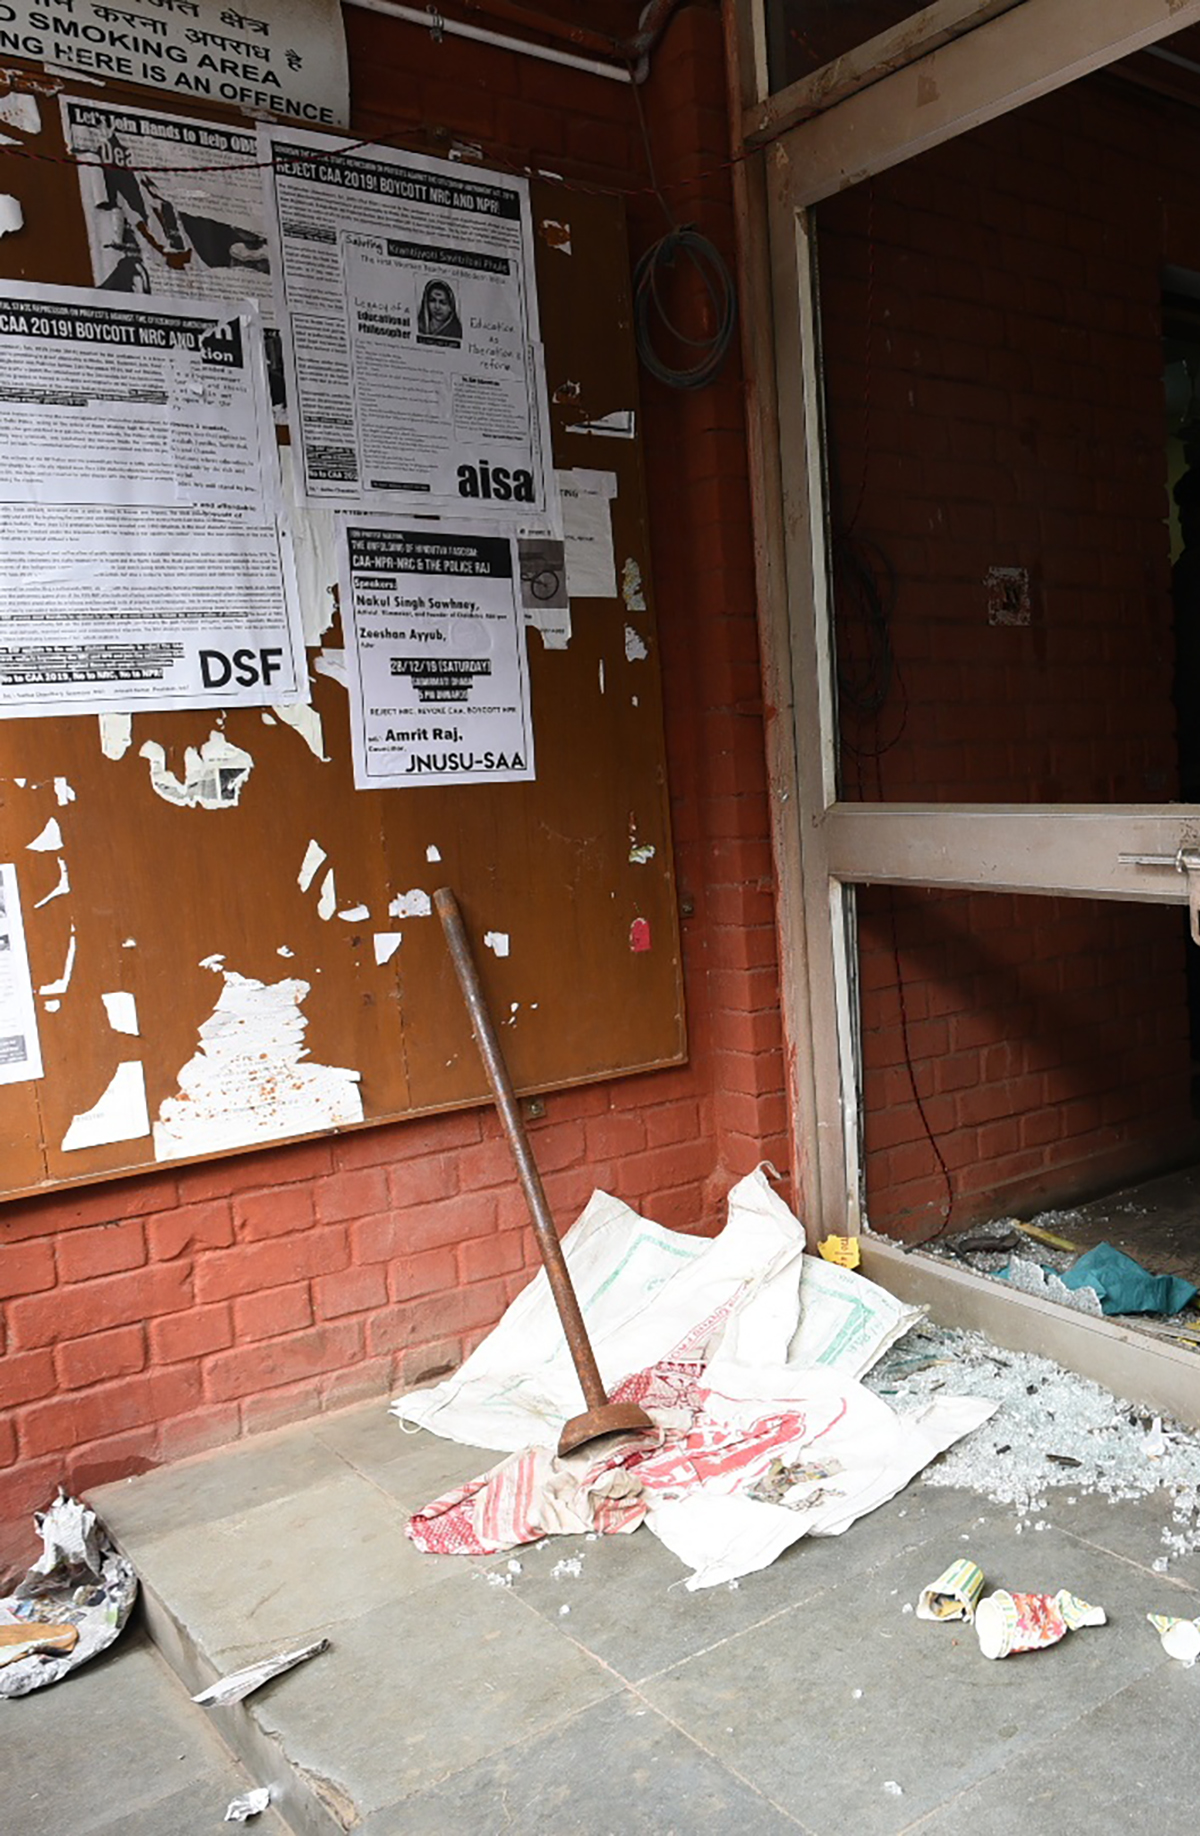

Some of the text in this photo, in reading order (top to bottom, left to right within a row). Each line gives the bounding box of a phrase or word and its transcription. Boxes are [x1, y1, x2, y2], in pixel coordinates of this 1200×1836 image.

[90, 3, 303, 72] करना अपराध है
[220, 7, 270, 36] क्षेत्र
[29, 12, 187, 63] SMOKING
[197, 54, 281, 88] AREA
[54, 42, 133, 76] HERE
[142, 62, 167, 82] IS
[174, 71, 210, 94] AN
[219, 82, 343, 126] OFFENCE.
[75, 108, 106, 127] Let's
[109, 114, 138, 137] Join
[140, 120, 181, 141] Hands
[183, 128, 197, 143] to
[199, 130, 228, 151] Help
[276, 157, 316, 179] REJECT
[319, 165, 342, 184] CAA
[344, 170, 378, 191] 2019!
[380, 178, 427, 200] BOYCOTT
[429, 186, 451, 205] NRC
[453, 192, 475, 210] AND
[0, 314, 28, 333] CAA
[31, 317, 73, 337] 2019!
[75, 321, 135, 343] BOYCOTT
[139, 327, 166, 346] NRC
[169, 330, 195, 348] AND
[457, 459, 536, 503] aisa
[425, 559, 442, 572] THE
[443, 560, 473, 573] POLICE
[475, 561, 491, 574] RAJ
[356, 595, 391, 607] Nakul
[394, 596, 426, 610] Singh
[359, 627, 447, 642] Zeeshan Ayyub,
[198, 648, 283, 689] DSF
[370, 707, 397, 716] REJECT
[467, 706, 501, 714] BOYCOTT
[385, 729, 429, 742] Amrit
[432, 727, 463, 743] Raj,
[405, 752, 524, 773] JNUSU-SAA
